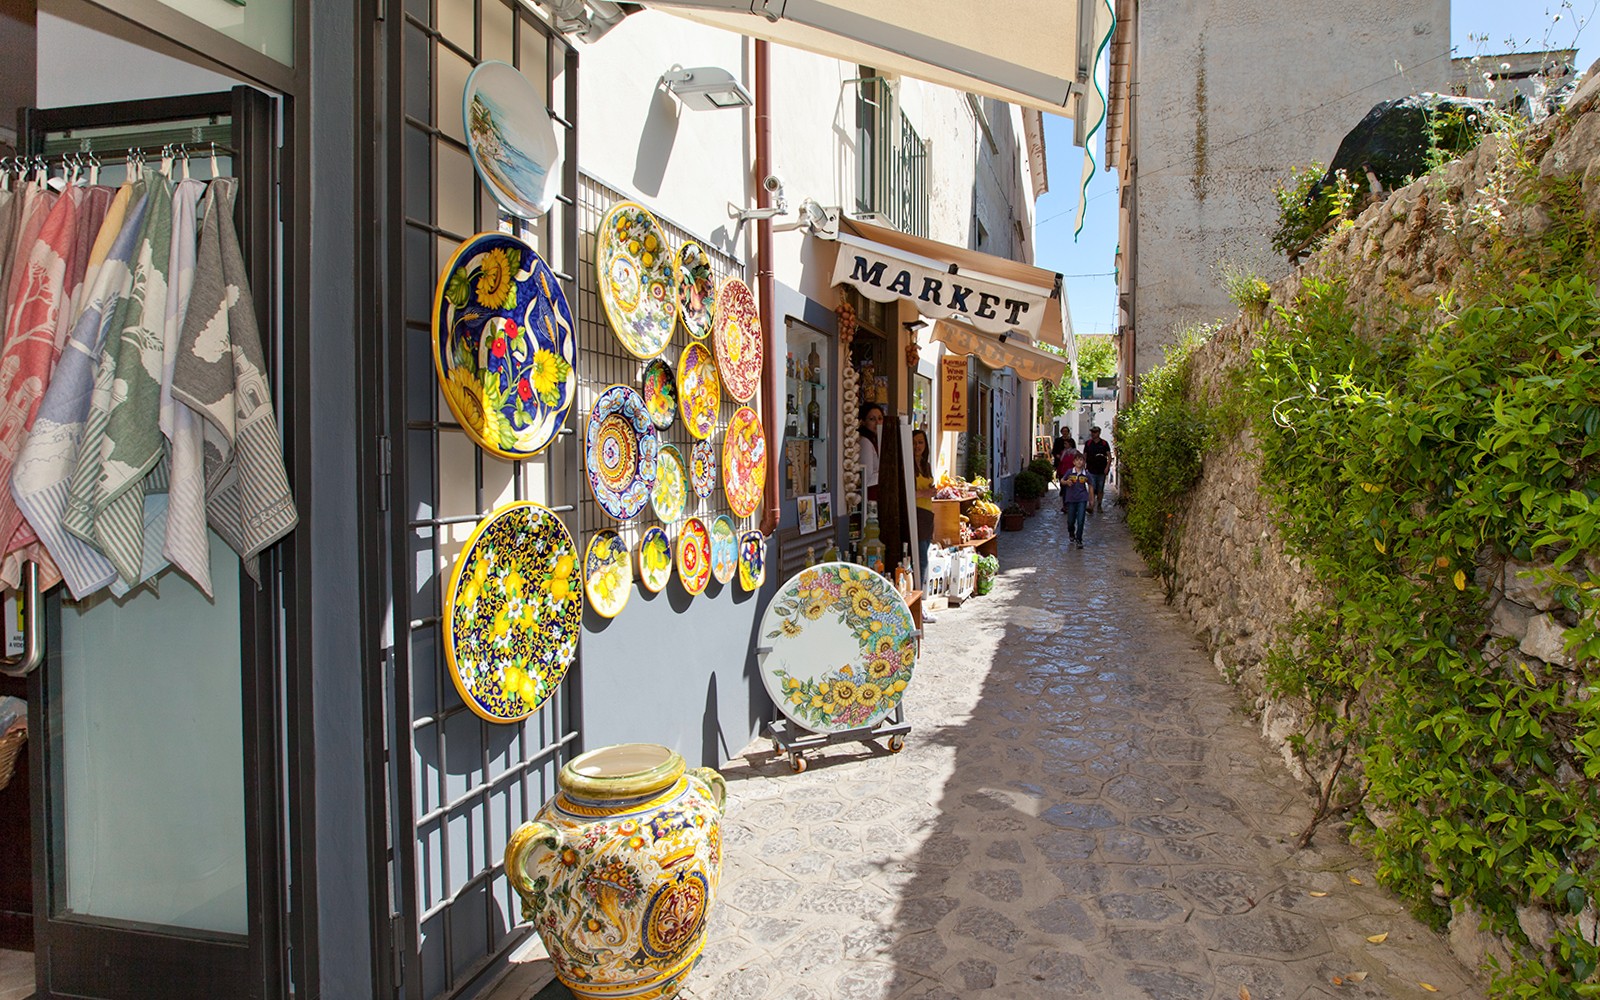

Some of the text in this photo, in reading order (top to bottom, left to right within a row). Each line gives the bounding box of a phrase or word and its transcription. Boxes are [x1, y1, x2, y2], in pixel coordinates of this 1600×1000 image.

[849, 256, 1029, 325] MARKET
[946, 366, 964, 375] WINE
[260, 497, 292, 522] RAVELL
